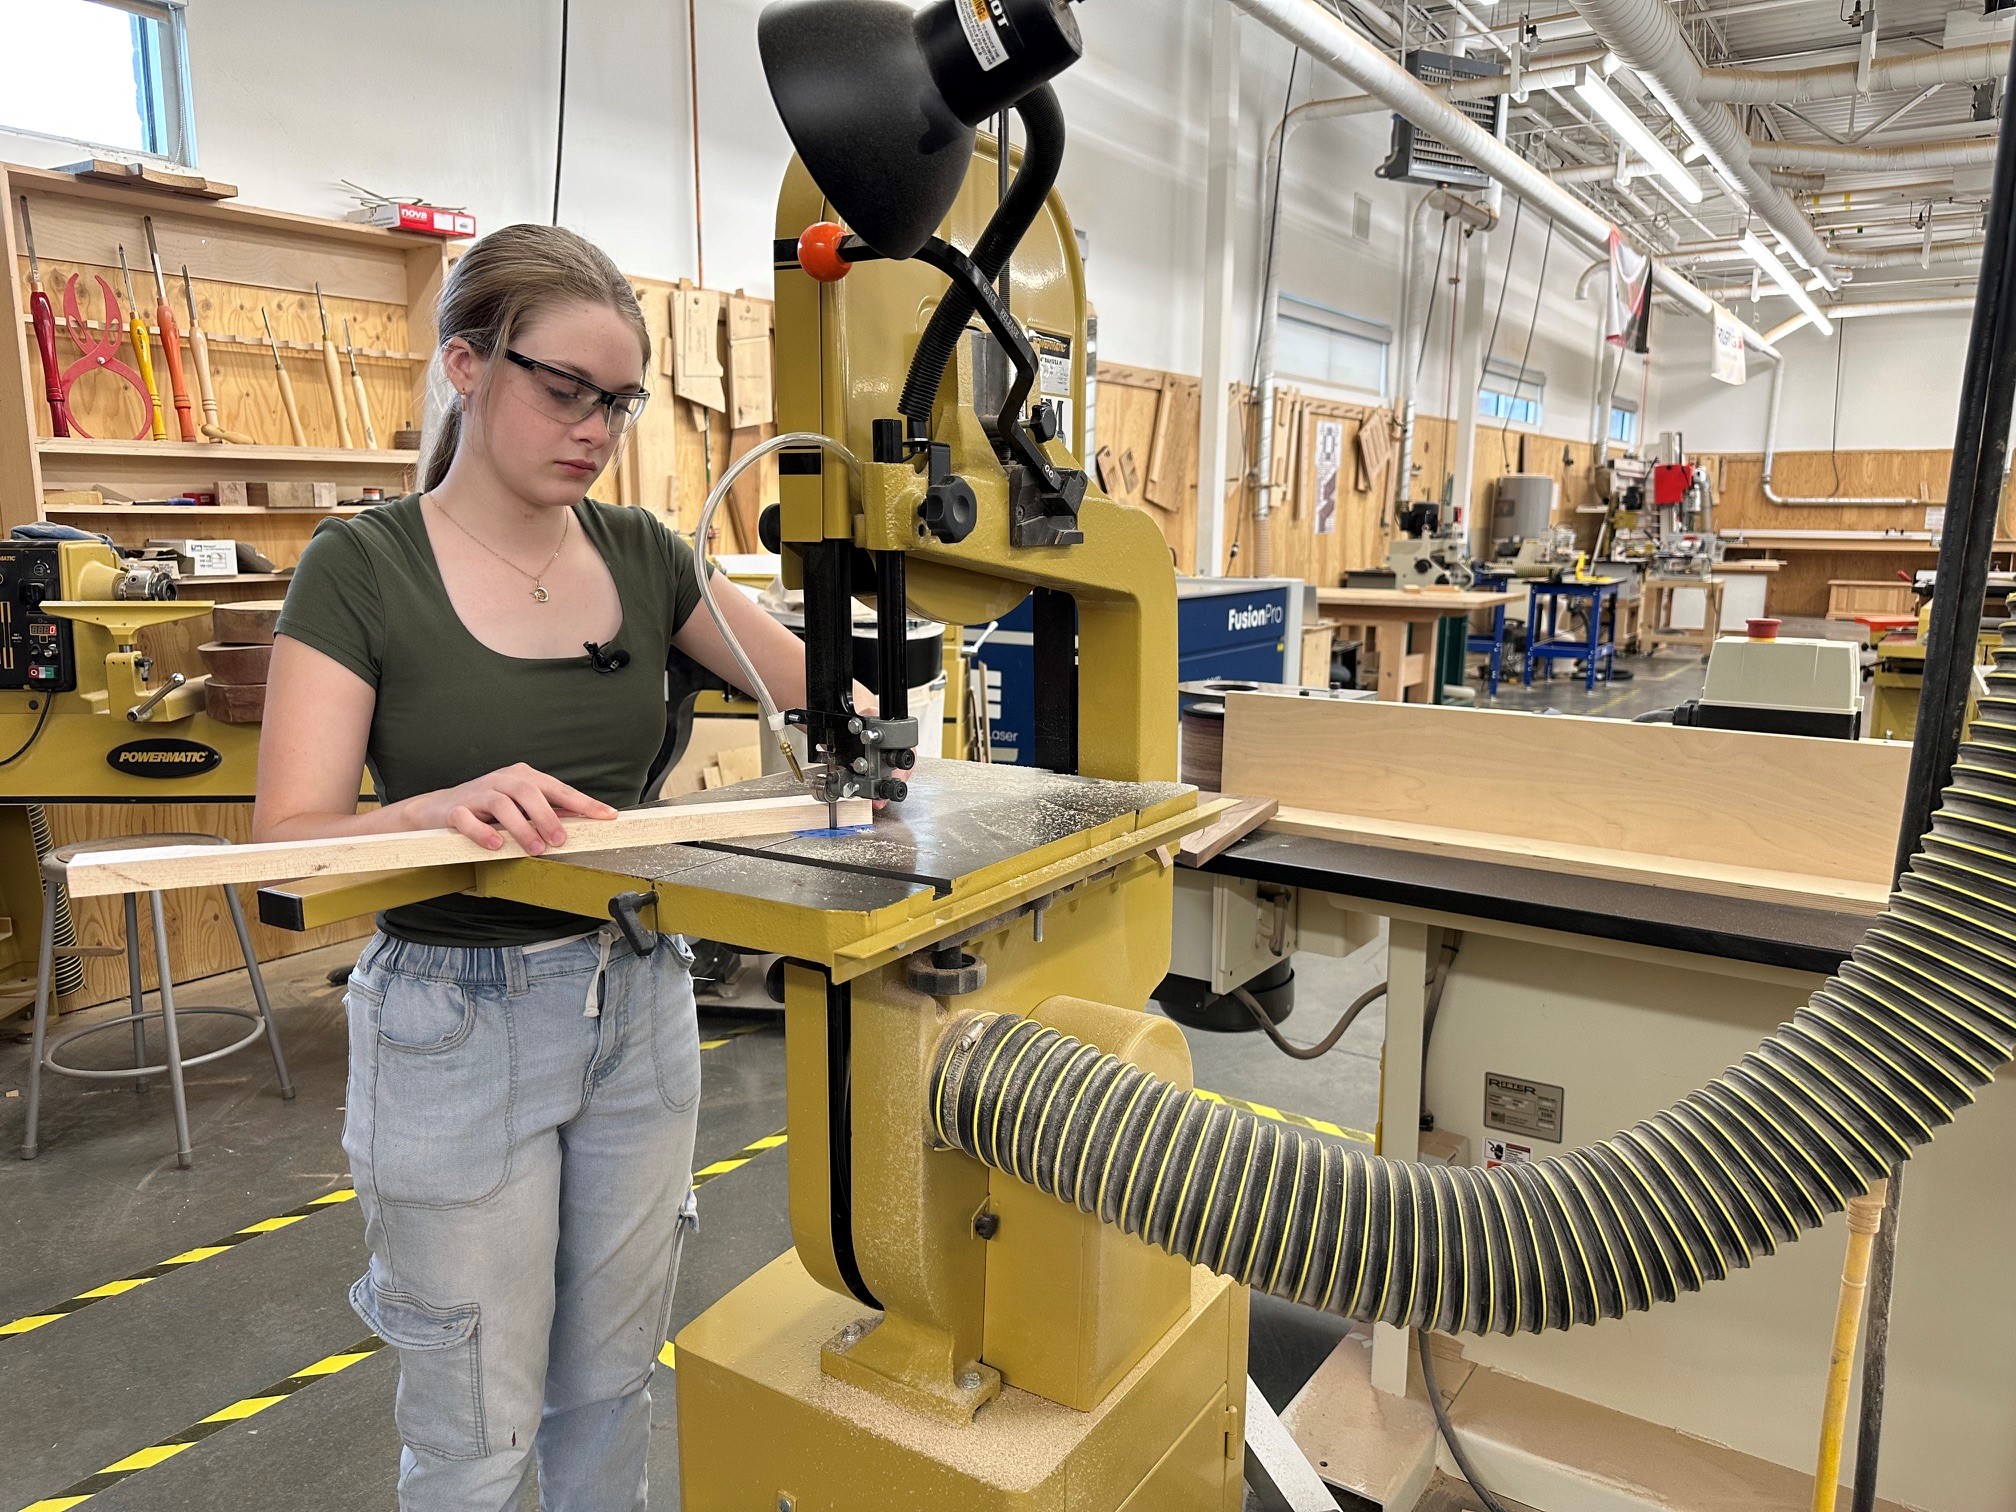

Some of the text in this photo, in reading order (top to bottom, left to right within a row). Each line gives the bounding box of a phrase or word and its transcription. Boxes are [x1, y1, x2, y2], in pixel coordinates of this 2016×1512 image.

[990, 0, 1009, 26] OT
[401, 208, 428, 219] nova
[983, 282, 998, 306] QUICK
[999, 308, 1020, 339] RELEASE
[1228, 603, 1283, 631] FusionPro
[990, 730, 1018, 742] aser
[119, 751, 206, 763] POWERMATIC
